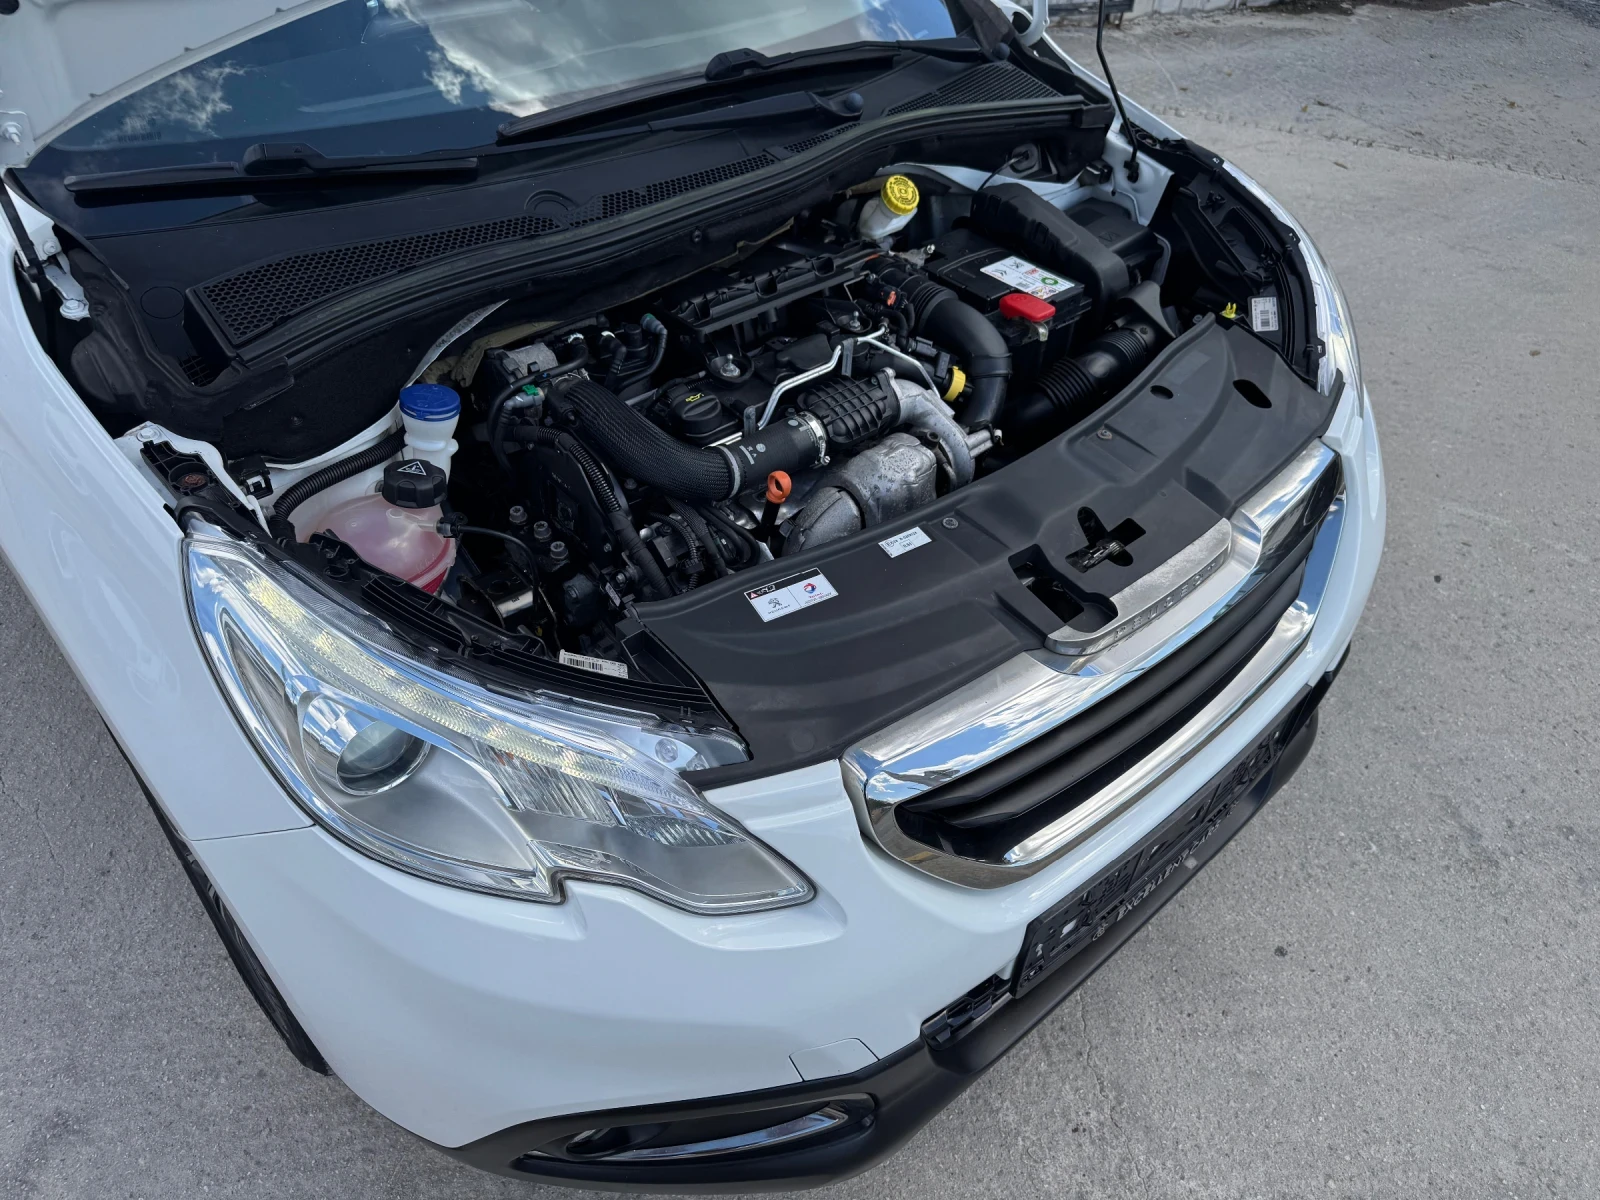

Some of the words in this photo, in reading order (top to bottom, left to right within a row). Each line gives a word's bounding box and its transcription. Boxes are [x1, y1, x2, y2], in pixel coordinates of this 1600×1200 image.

[1115, 562, 1216, 640] PEUGEOT
[1117, 849, 1190, 921] EXCELLENT
[1189, 819, 1221, 854] CARS
